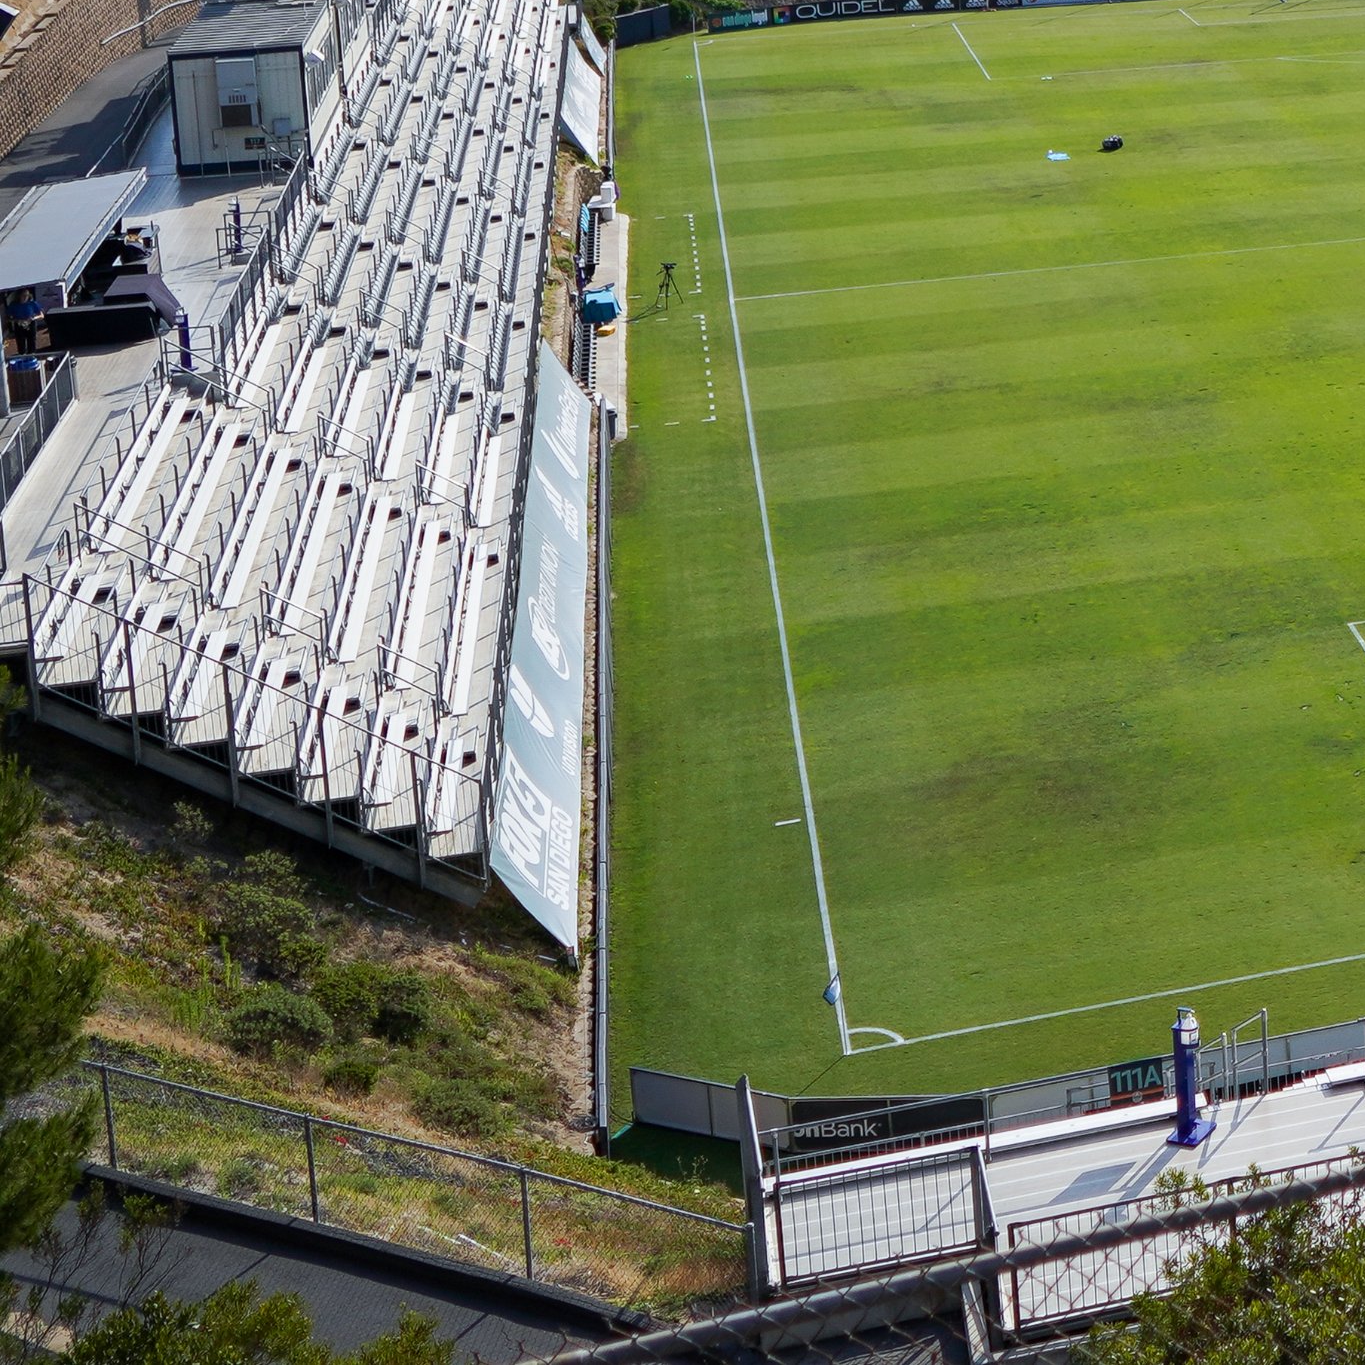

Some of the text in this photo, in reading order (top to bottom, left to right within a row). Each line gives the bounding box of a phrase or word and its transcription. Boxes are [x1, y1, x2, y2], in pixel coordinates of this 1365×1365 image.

[796, 0, 896, 20] QUIDEL
[500, 784, 543, 888] FOX
[545, 805, 574, 911] SAN DIEGO
[1110, 1064, 1163, 1094] 111A
